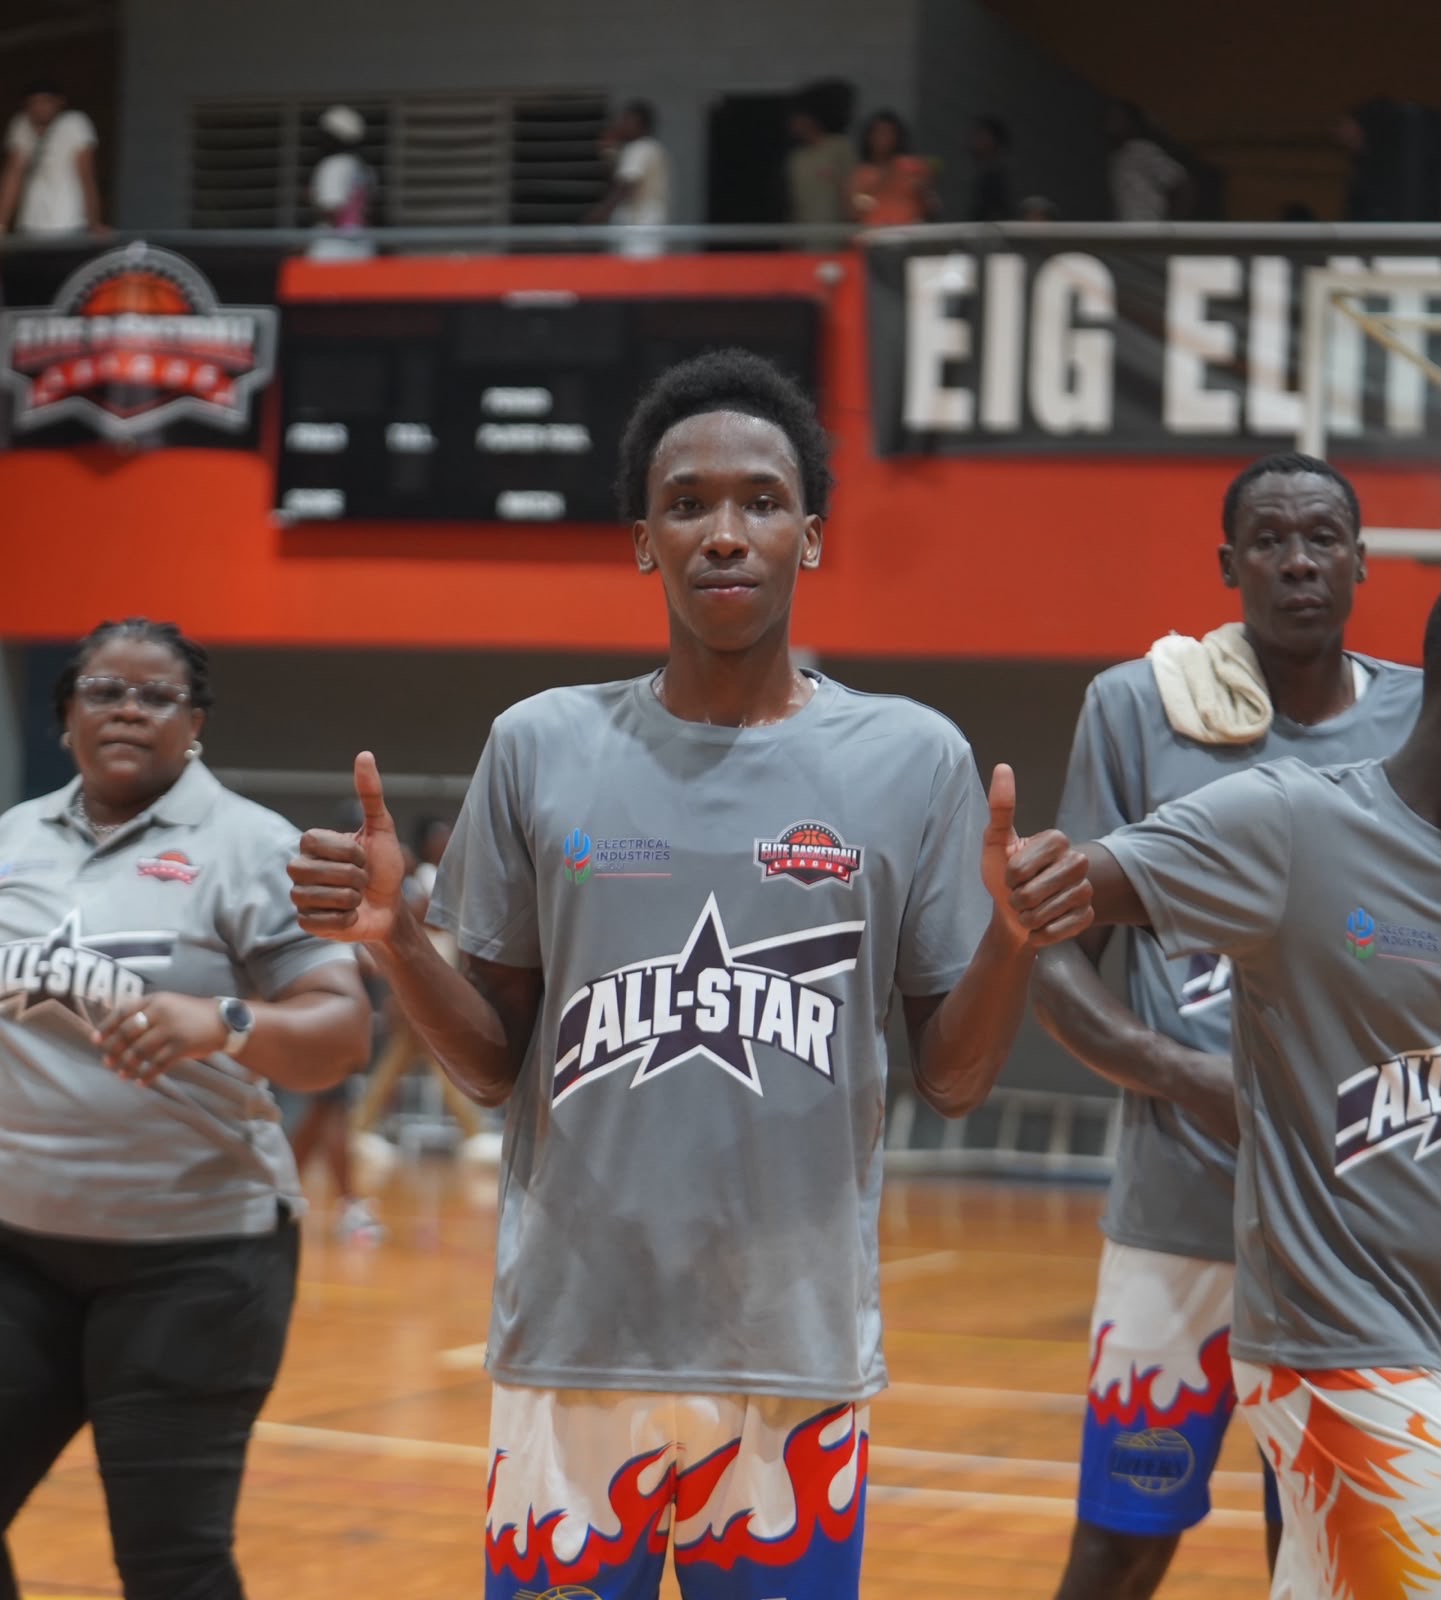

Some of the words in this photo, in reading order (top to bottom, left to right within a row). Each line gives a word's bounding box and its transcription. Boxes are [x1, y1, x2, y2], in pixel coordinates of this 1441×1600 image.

[904, 252, 1114, 434] EIG
[596, 850, 670, 861] INDUSTRIES
[597, 839, 671, 849] ELECTRICAL
[761, 843, 790, 860] ELITE
[791, 844, 858, 868] BASKETBALL
[774, 859, 845, 873] LEAGUE
[0, 944, 145, 1012] LL-STAR
[579, 967, 835, 1077] ALL-STAR
